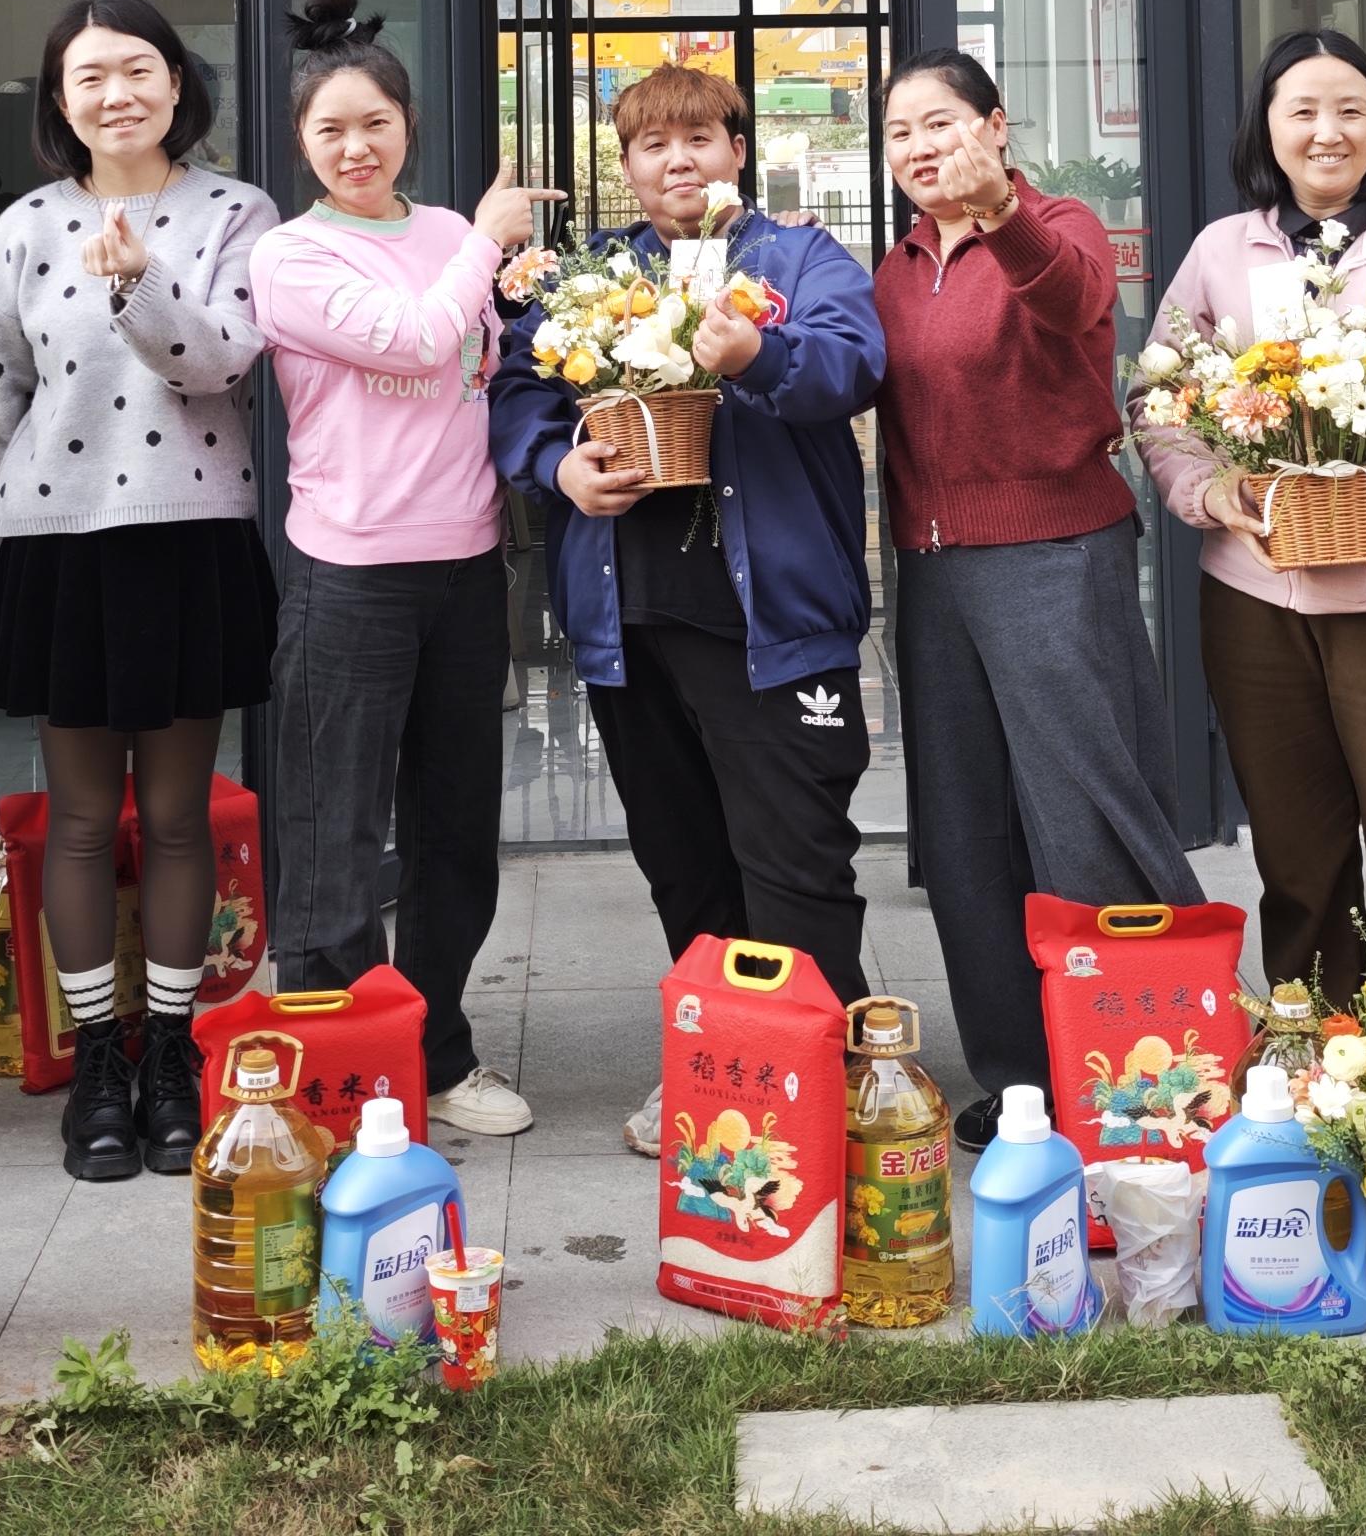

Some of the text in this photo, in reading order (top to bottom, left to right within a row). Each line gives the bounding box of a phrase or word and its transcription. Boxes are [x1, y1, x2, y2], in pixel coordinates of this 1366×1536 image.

[363, 372, 441, 400] YOUNG
[800, 714, 845, 727] adidas
[688, 1051, 779, 1095] 稻香米
[879, 1136, 949, 1178] 金龙鱼
[1034, 1226, 1075, 1268] 蓝月亮
[1234, 1216, 1306, 1239] 蓝月亮
[370, 1243, 431, 1283] 蓝月亮
